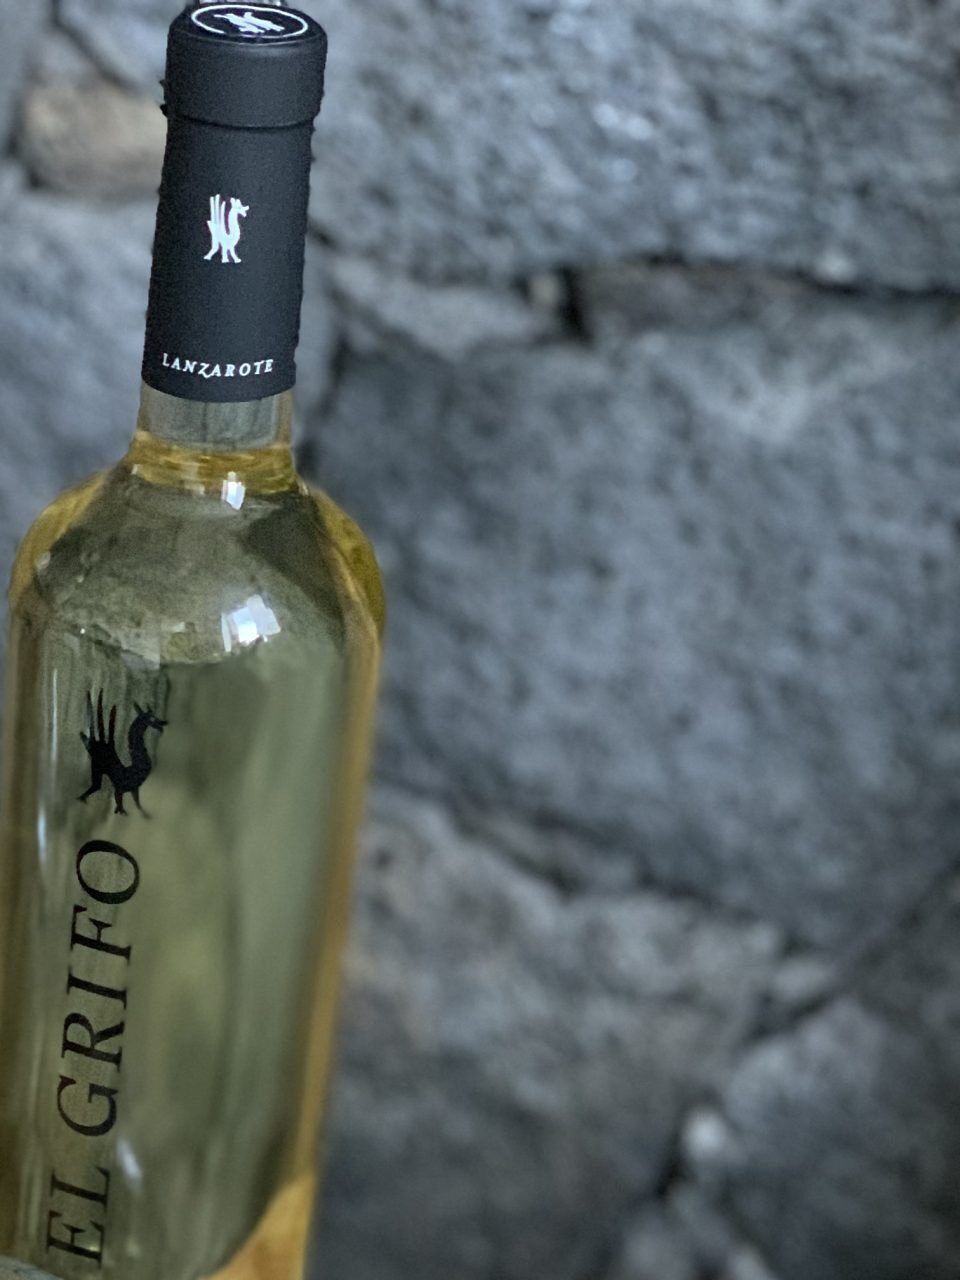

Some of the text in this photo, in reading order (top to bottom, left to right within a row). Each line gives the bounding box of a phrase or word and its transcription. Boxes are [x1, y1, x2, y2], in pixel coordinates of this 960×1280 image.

[162, 353, 274, 378] LANZAROTE
[46, 840, 140, 1268] EL GRIFO
